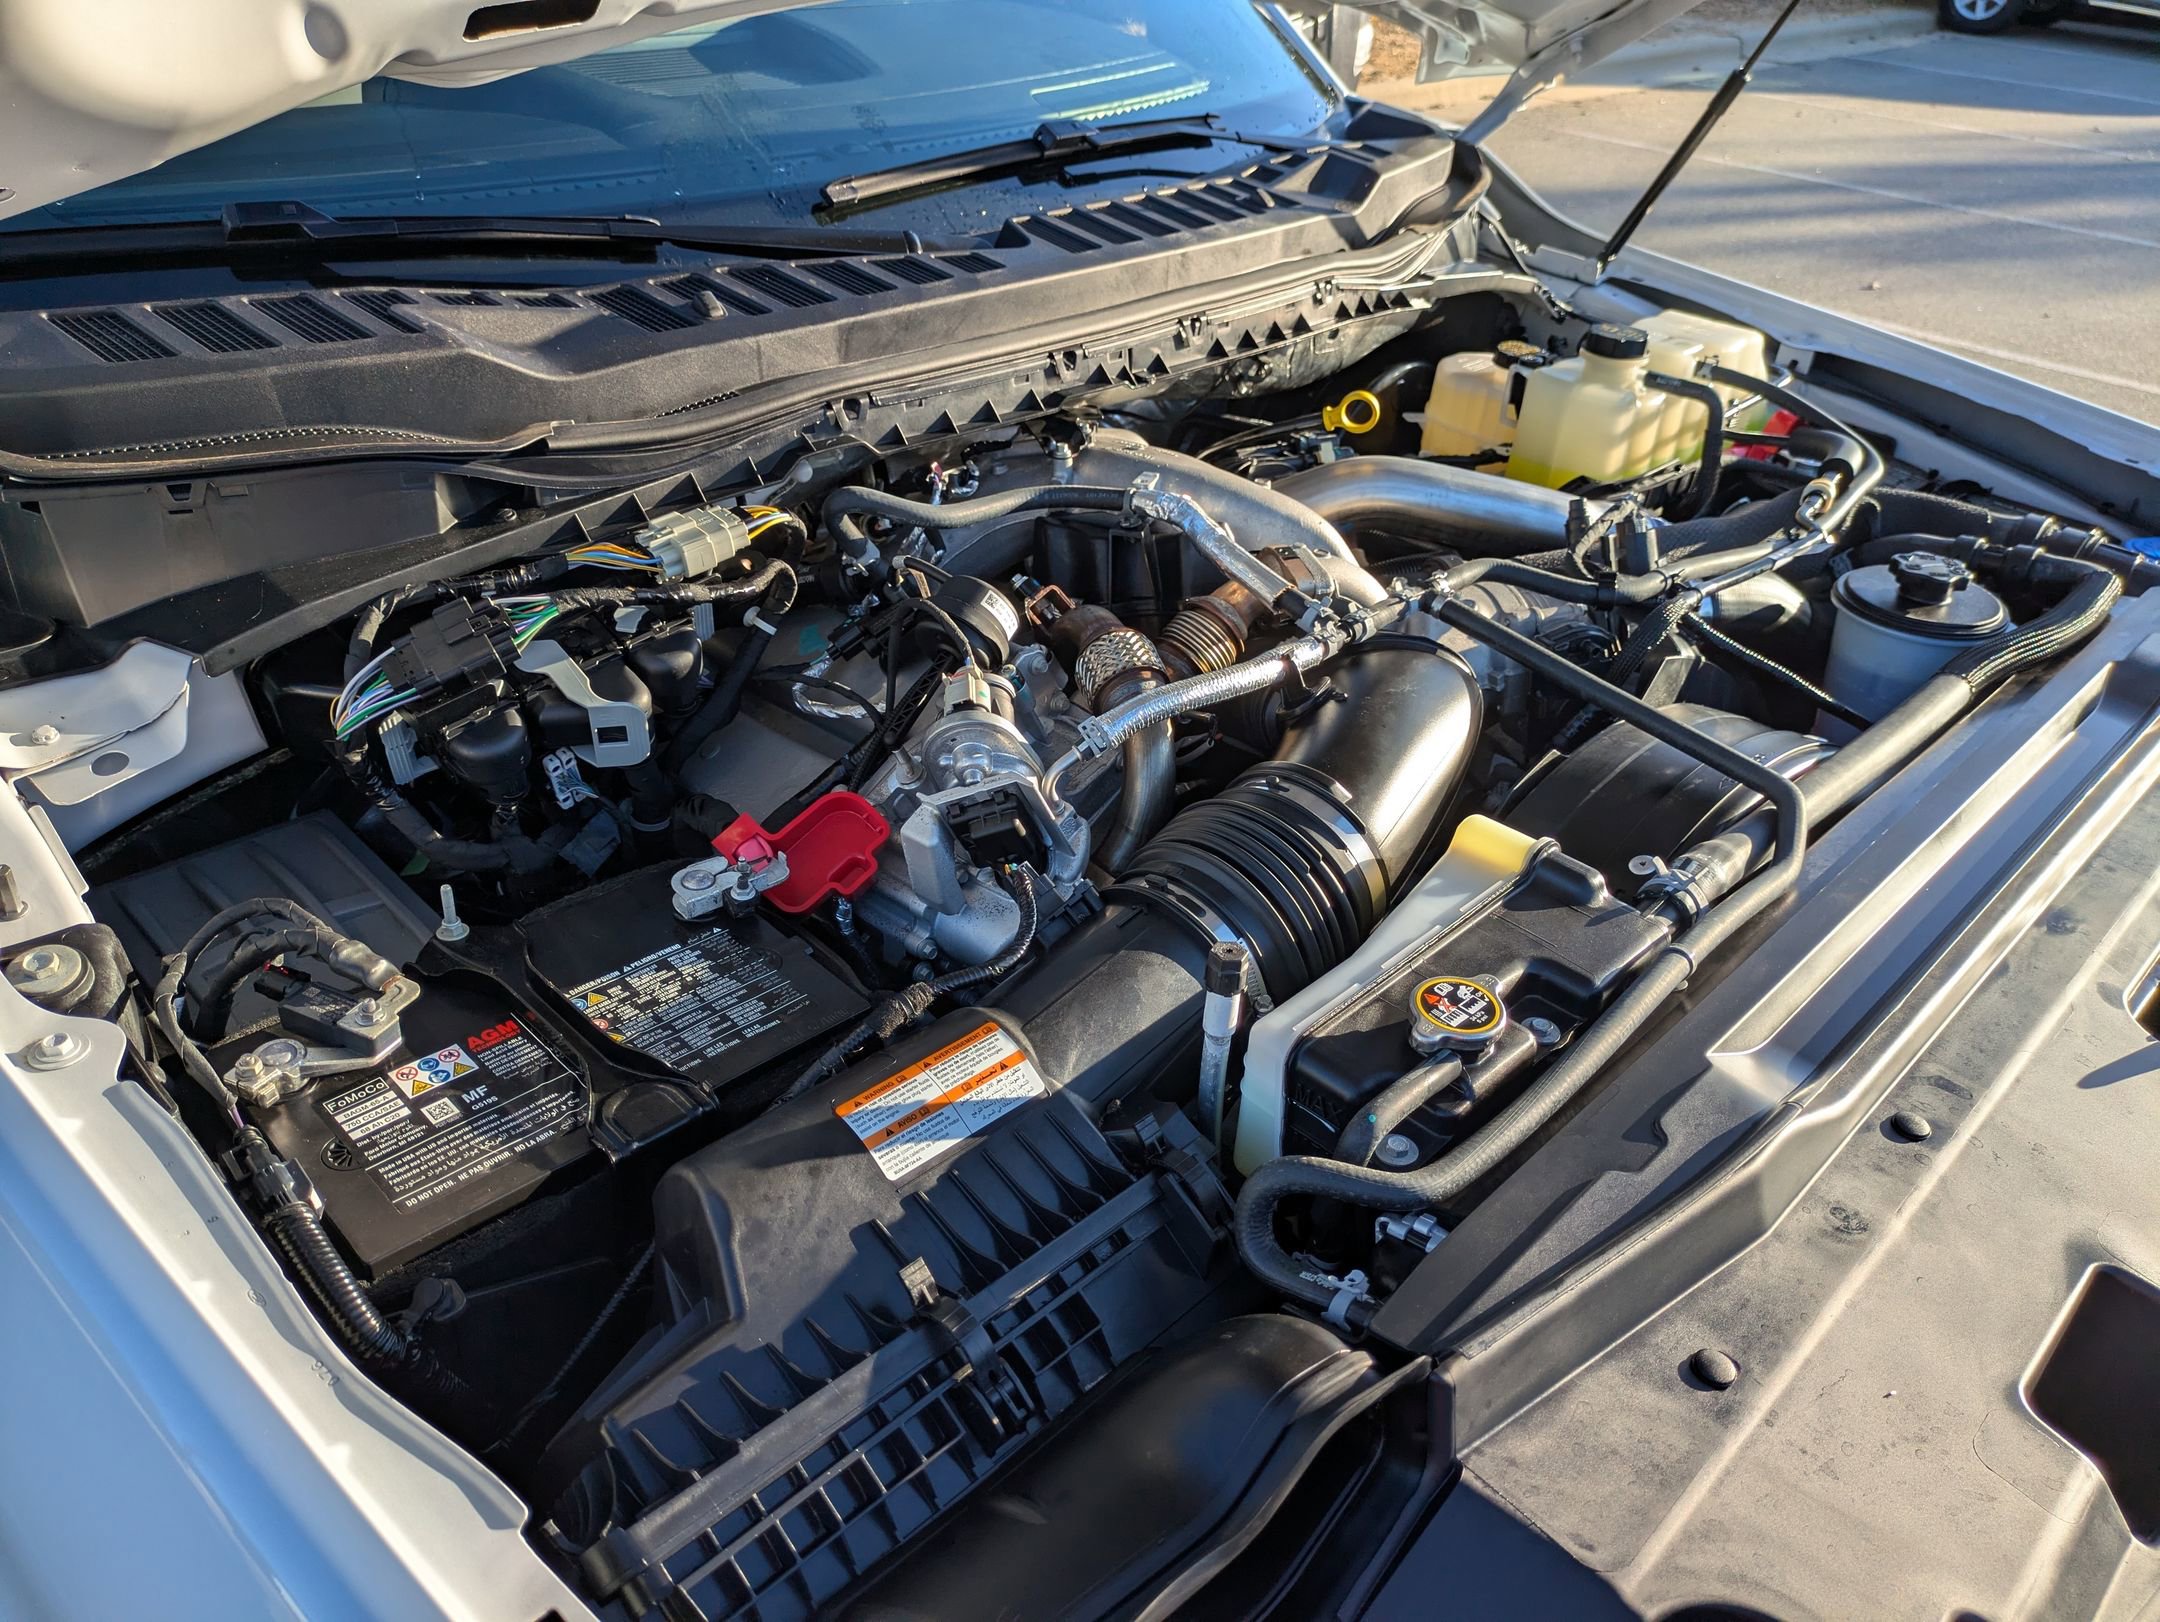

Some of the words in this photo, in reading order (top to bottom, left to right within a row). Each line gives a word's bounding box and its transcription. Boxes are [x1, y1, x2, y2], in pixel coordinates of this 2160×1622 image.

[568, 970, 621, 995] DANGER/POISON
[629, 943, 682, 968] PELIGRO/VENENO
[464, 1018, 519, 1049] AGM
[932, 1031, 981, 1061] AVERTISSEMENT
[327, 1080, 385, 1111] FoMoCo
[461, 1084, 490, 1103] MF
[862, 1080, 894, 1101] WARNING
[345, 1118, 361, 1128] 750
[361, 1100, 400, 1121] CCA/SAE
[383, 1112, 400, 1123] C20
[896, 1113, 917, 1128] AVISO
[363, 1146, 379, 1156] Ford
[378, 1137, 397, 1149] Motor
[378, 1162, 395, 1173] Made
[417, 1189, 434, 1201] NOT
[432, 1177, 457, 1193] OPEN.
[467, 1164, 484, 1175] PAS
